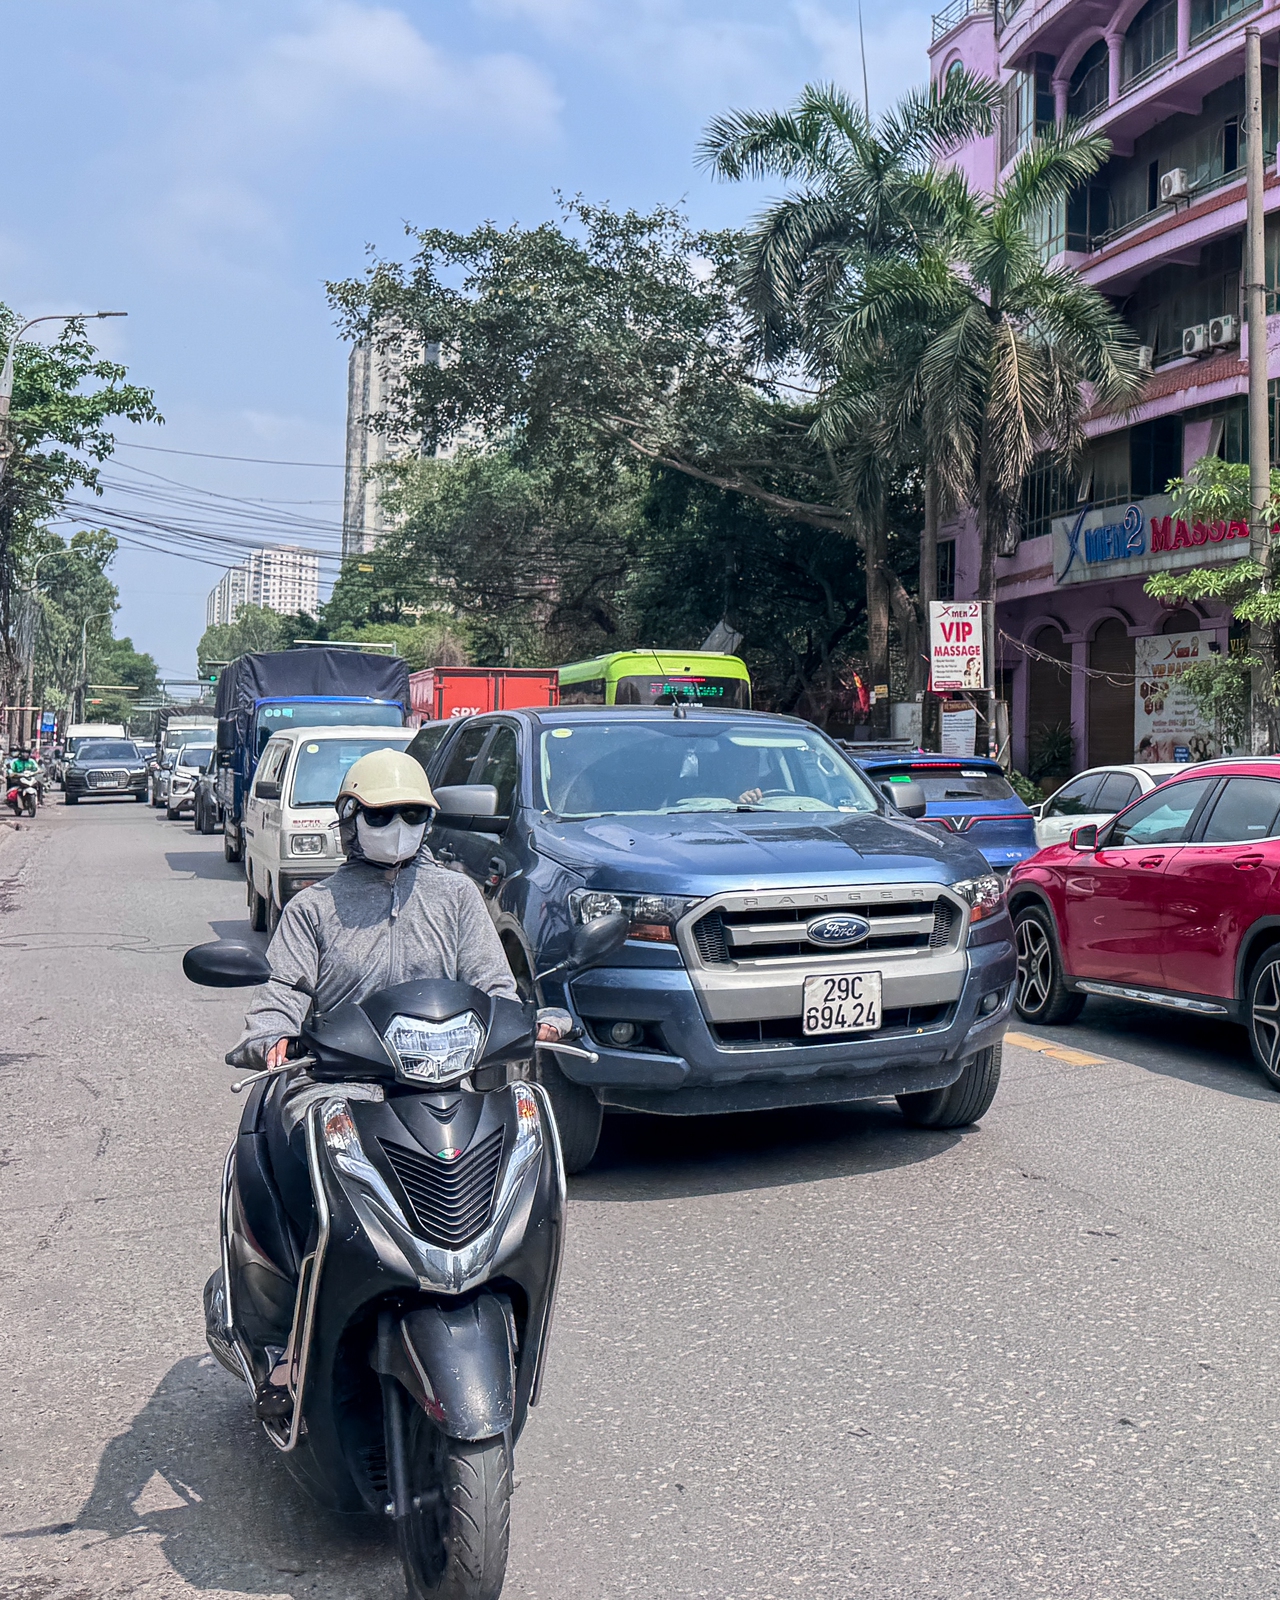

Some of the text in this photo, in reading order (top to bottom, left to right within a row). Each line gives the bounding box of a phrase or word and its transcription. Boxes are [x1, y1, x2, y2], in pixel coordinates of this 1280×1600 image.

[940, 622, 973, 642] VIP
[934, 645, 980, 657] MASSAGE
[744, 889, 924, 906] RANGER
[823, 921, 857, 938] Ford
[824, 976, 863, 1002] 29C
[806, 1001, 876, 1031] 694.24
